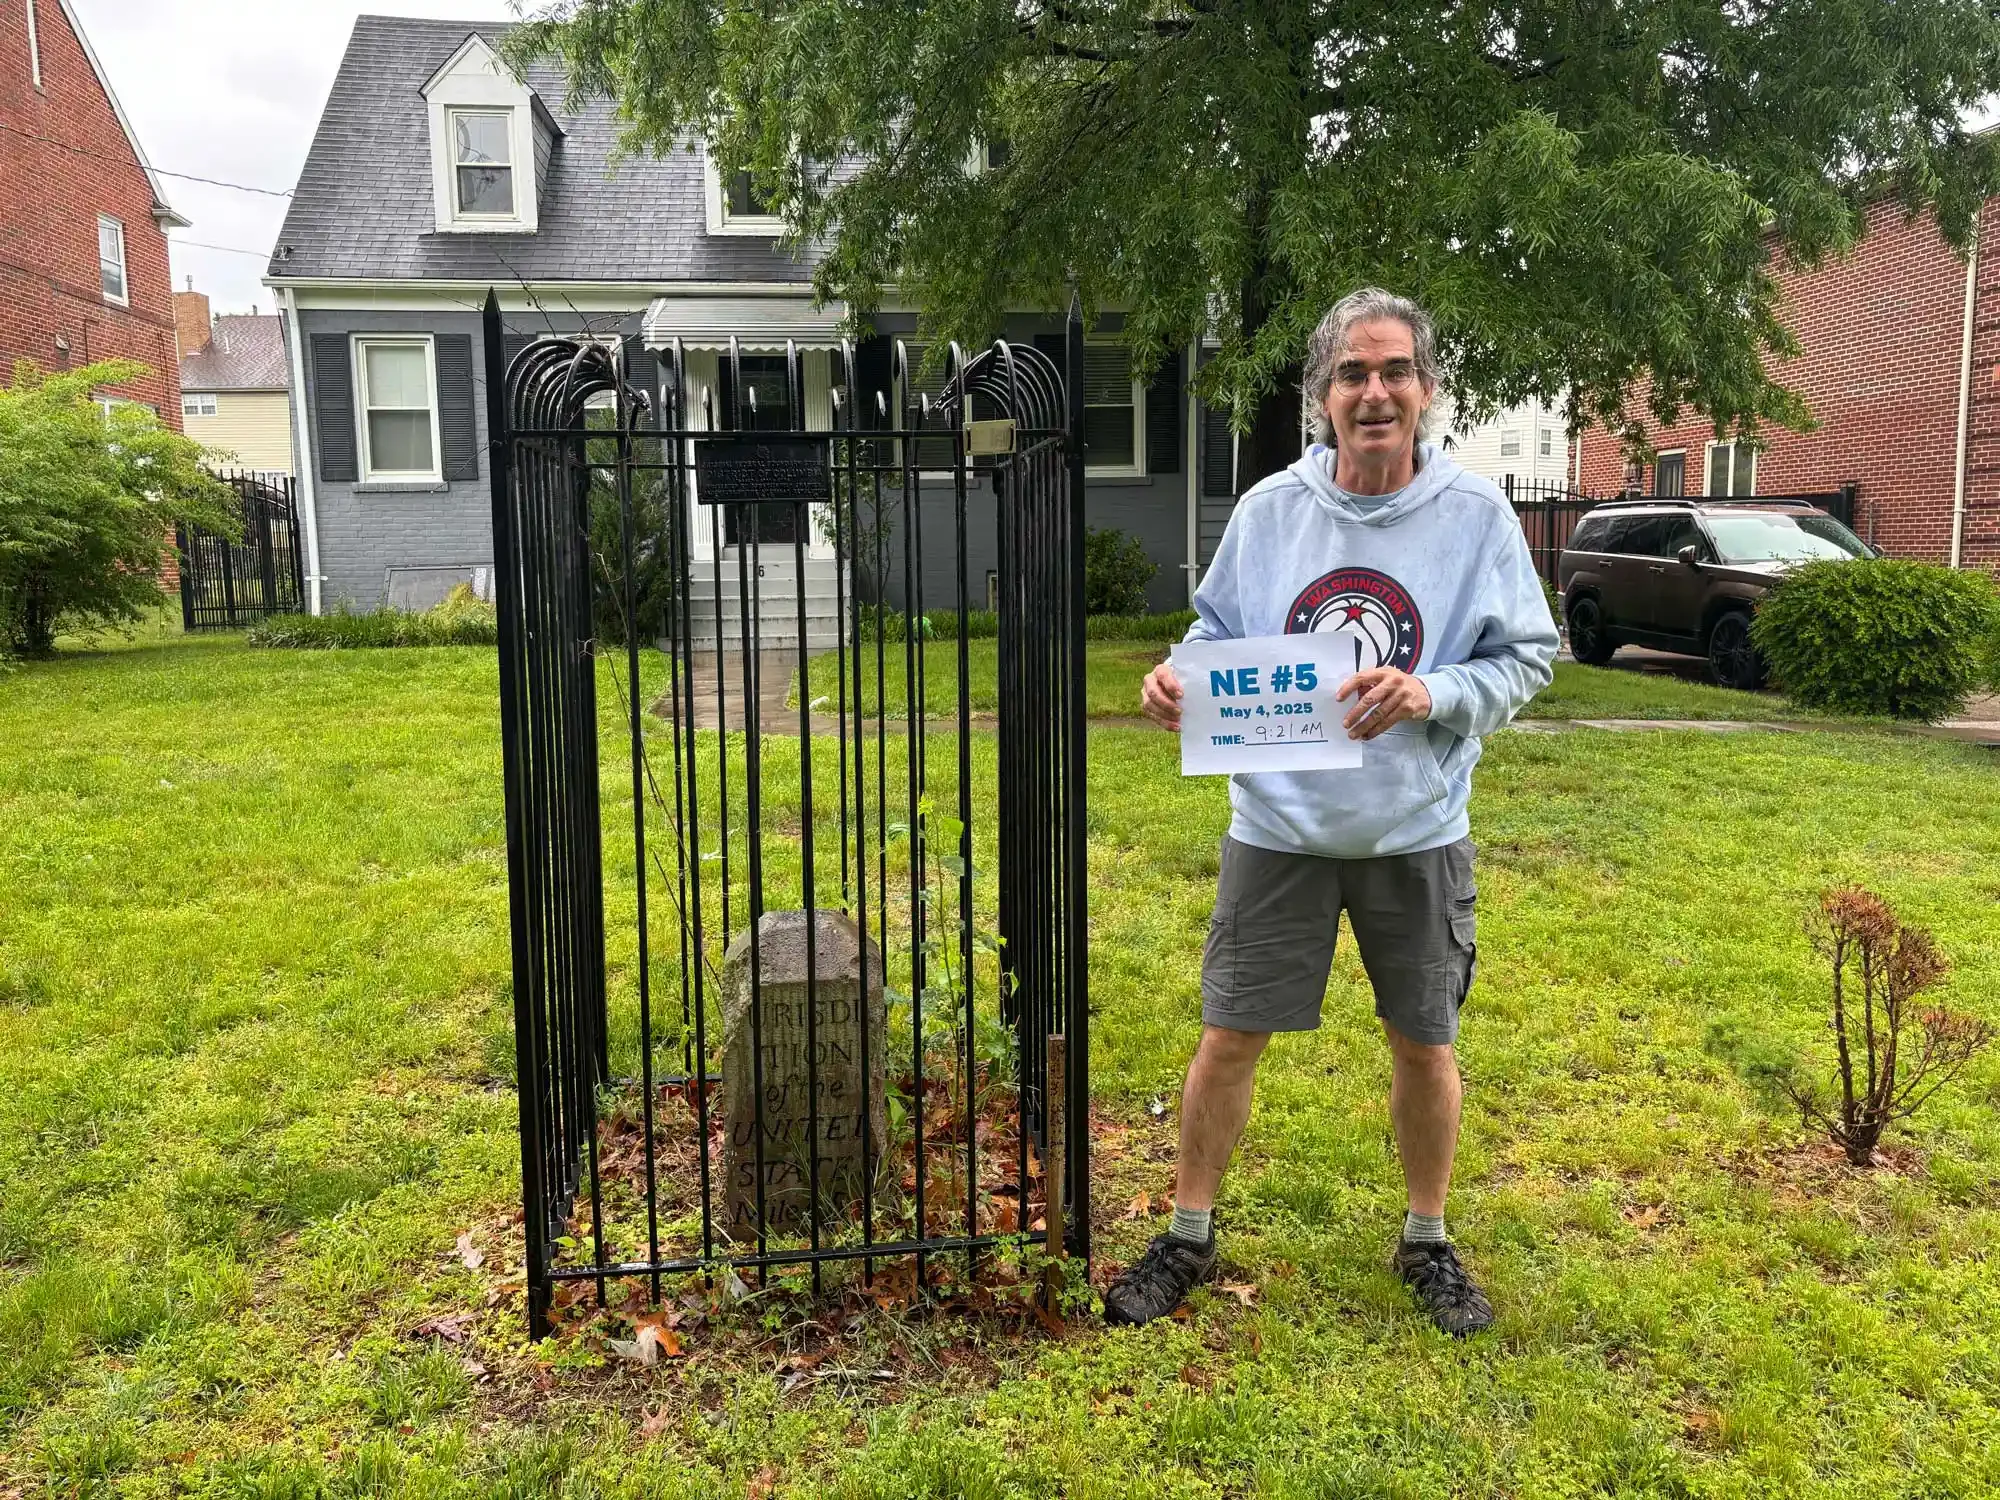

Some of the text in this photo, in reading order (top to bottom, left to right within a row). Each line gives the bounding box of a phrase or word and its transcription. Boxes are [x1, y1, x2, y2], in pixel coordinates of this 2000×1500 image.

[1304, 577, 1407, 616] WASHINGTON
[1209, 663, 1318, 697] NE #5
[1220, 702, 1313, 720] May 4, 2025
[1211, 721, 1324, 746] TIME: 9:21 AM
[760, 1040, 853, 1069] TION
[766, 1073, 799, 1112] of
